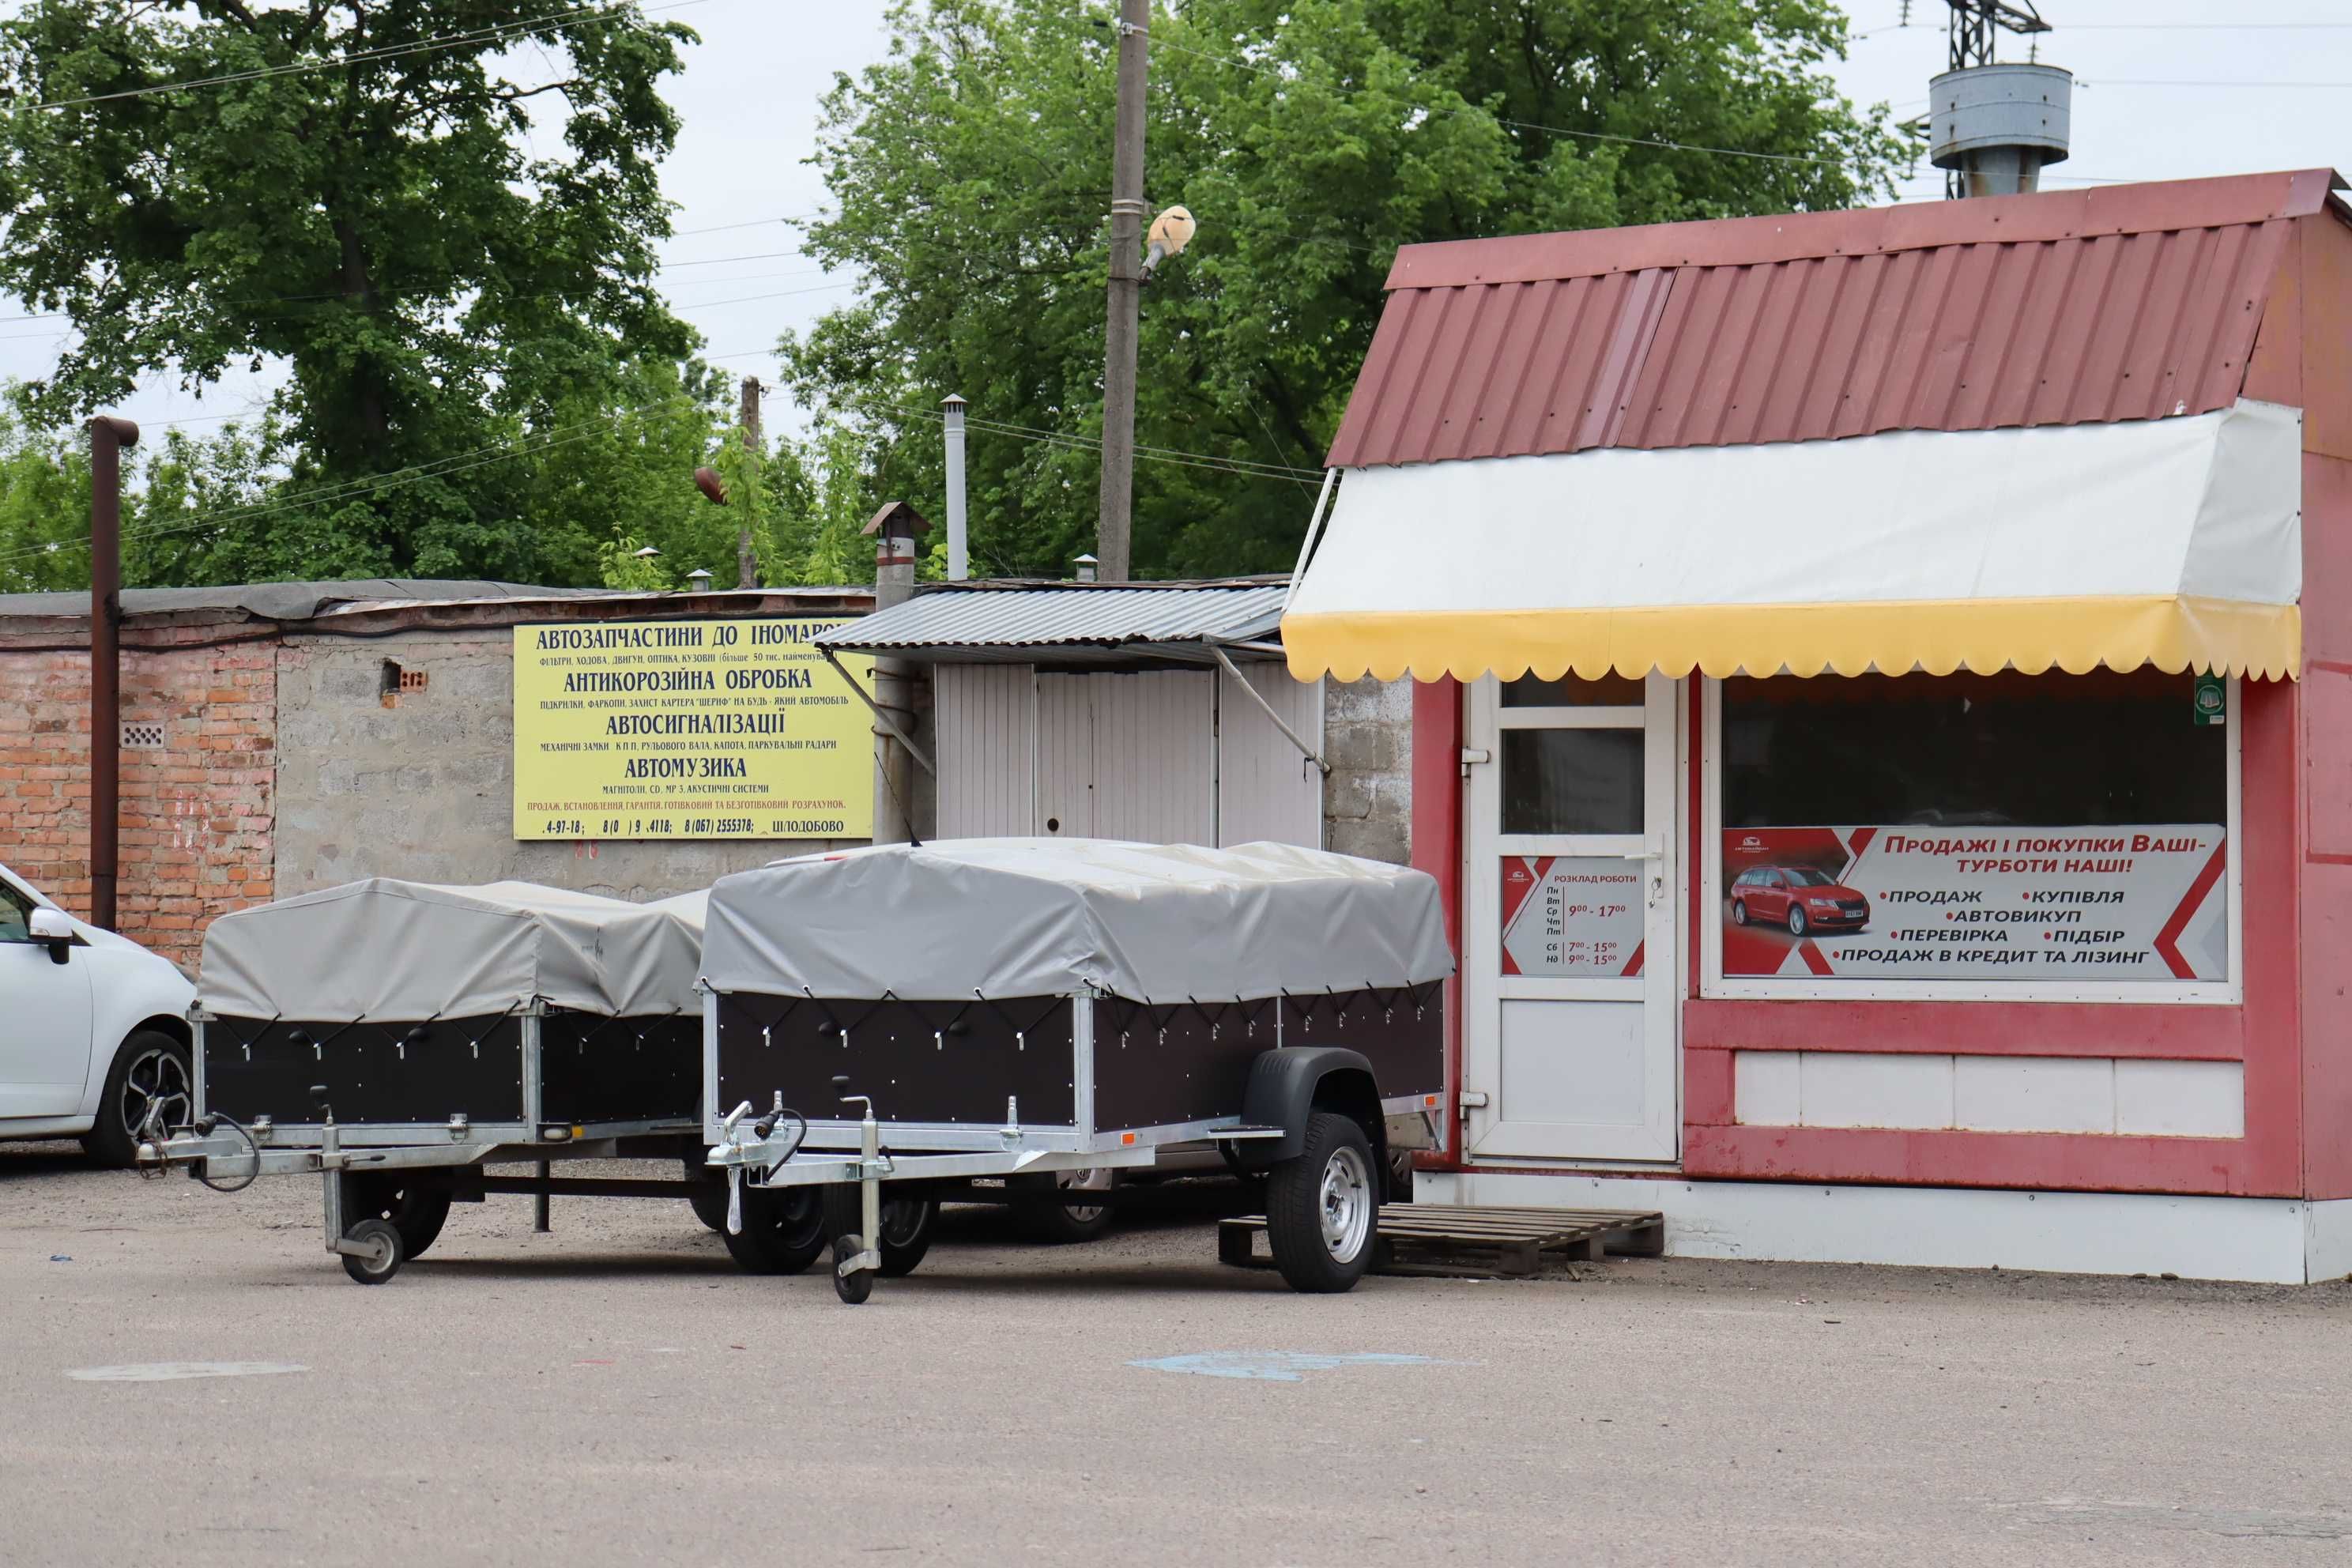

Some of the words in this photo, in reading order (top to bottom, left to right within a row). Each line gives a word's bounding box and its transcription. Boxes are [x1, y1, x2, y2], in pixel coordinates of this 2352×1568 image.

[536, 627, 703, 650] АВТОЗАПЧАСТИНИ
[712, 625, 737, 650] ДО
[575, 656, 610, 665] ХОДОВА,
[612, 654, 646, 665] ДВИГУН,
[719, 652, 748, 663] (більше
[753, 652, 763, 662] 50
[765, 653, 781, 662] тис.
[564, 668, 715, 692] АНТИКОРОЗІЙНА
[726, 669, 812, 690] ОБРОБКА
[629, 698, 658, 708] ЗАХИСТ
[662, 698, 694, 707] КАРТЕРА
[734, 697, 744, 706] НА
[747, 696, 767, 706] БУДЬ
[775, 695, 796, 705] ЯКИЙ
[800, 695, 849, 705] АВТОМОБІЛЬ
[606, 708, 785, 736] АВТОСИГНАЛІЗАЦІЇ
[541, 742, 581, 752] МЕХАНІЧНІ
[583, 741, 609, 751] ЗАМКИ
[642, 741, 686, 750] РУЛЬОВОГО
[689, 741, 711, 750] ВАЛА,
[714, 741, 746, 750] КАПОТА,
[748, 740, 803, 749] ПАРКУВАЛЬНІ
[805, 740, 836, 749] РАДАРИ
[624, 757, 747, 778] АВТОМУЗИКА
[687, 784, 730, 793] АКУСТИЧНІ
[733, 784, 769, 793] СИСТЕМИ
[664, 799, 712, 810] ГОТІВКОВИЙ
[716, 801, 724, 809] ТА
[726, 799, 789, 809] БЕЗГОТІВКОВИЙ
[792, 800, 846, 809] РОЗРАХУНОК.
[772, 820, 844, 832] ЦІЛОДОБОВО
[2015, 839, 2124, 853] ПОКУПКИ
[1957, 859, 2057, 873] ТУРБОТИ
[2064, 859, 2133, 873] НАШІ!
[1555, 875, 1598, 884] РОЗКЛАД
[1547, 886, 1559, 895] Пн
[1889, 891, 1983, 905] ПРОДАЖ
[2032, 891, 2124, 903] КУПІВЛЯ
[1954, 910, 2082, 923] АВТОВИКУП
[1900, 929, 2008, 941] ПЕРЕВІРКА
[2054, 930, 2124, 944] ПІДБІР
[1547, 943, 1558, 952] Сб
[1841, 949, 1933, 963] ПРОДАЖ
[1939, 951, 1951, 962] В
[1957, 951, 2038, 964] КРЕДИТ
[2044, 951, 2067, 963] ТА
[2071, 951, 2150, 964] ЛІЗИНГ
